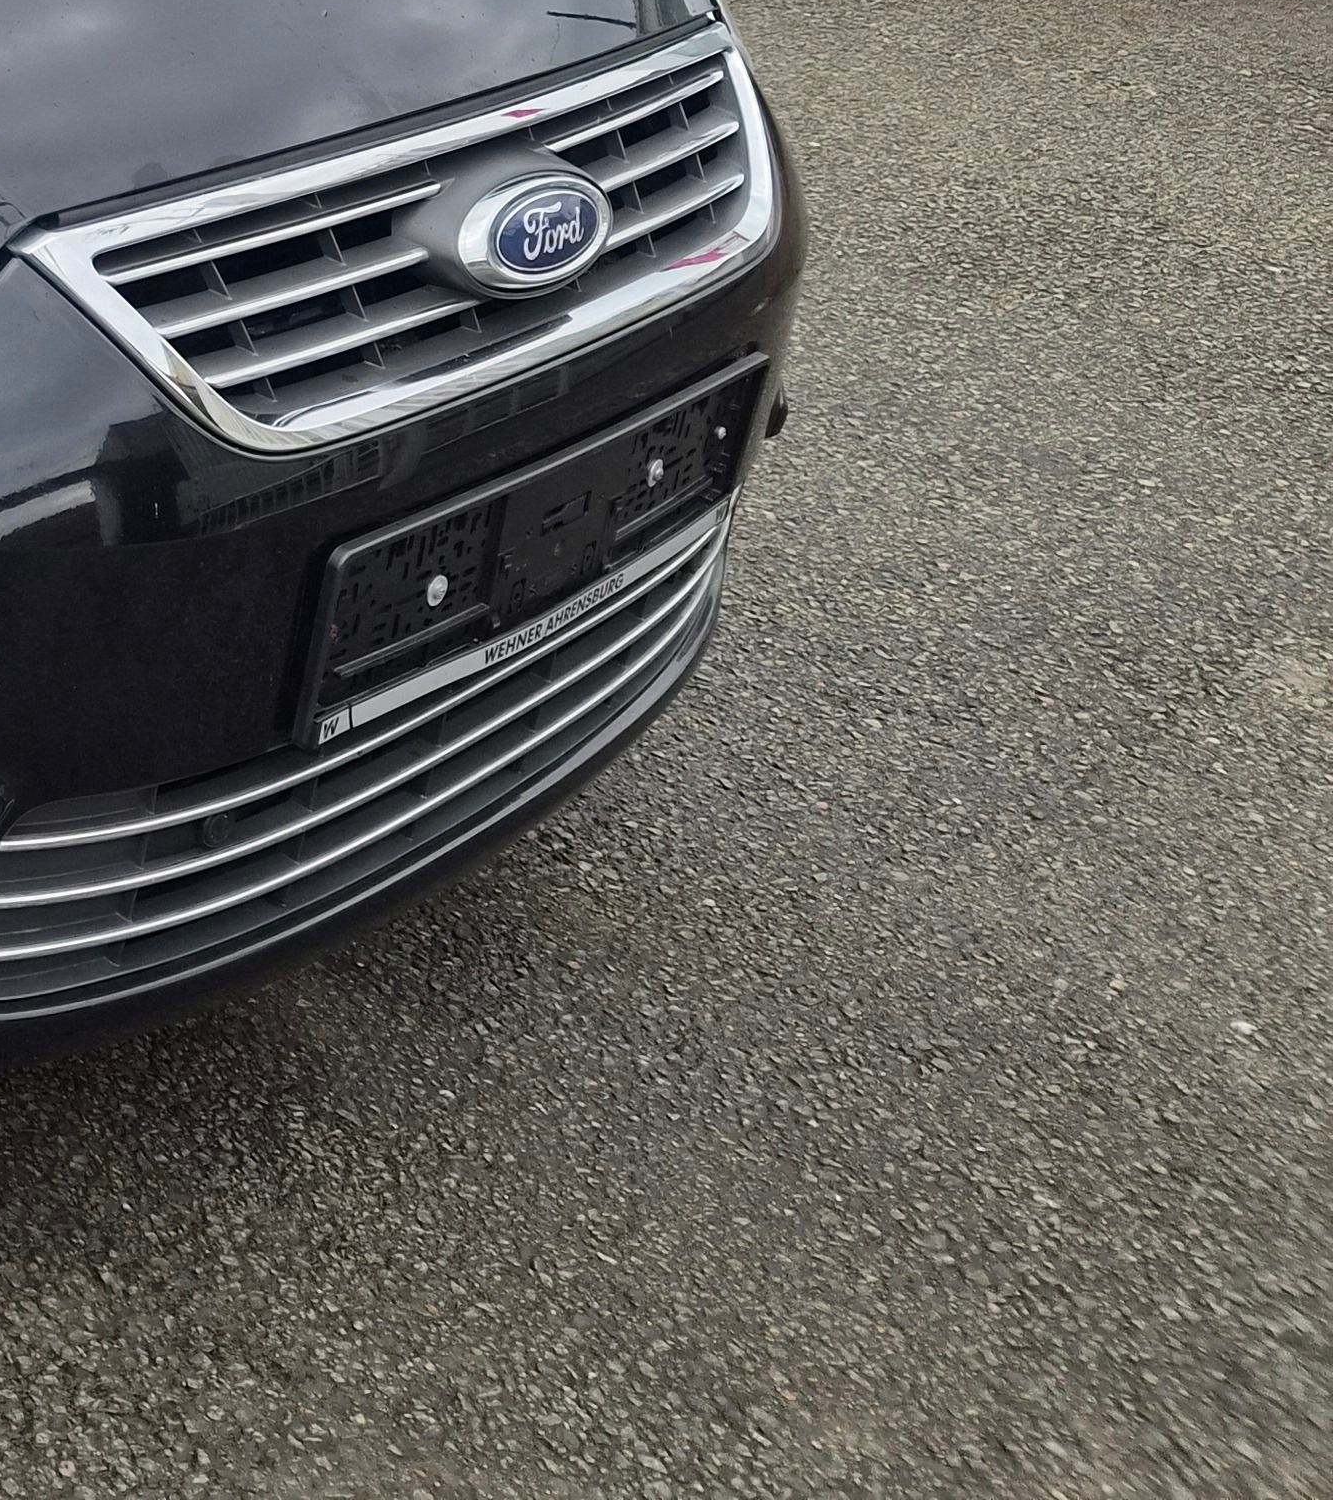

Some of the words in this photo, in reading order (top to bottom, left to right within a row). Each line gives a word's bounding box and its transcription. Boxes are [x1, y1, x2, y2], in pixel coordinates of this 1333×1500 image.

[523, 201, 585, 260] Ford
[324, 716, 340, 740] W
[484, 623, 543, 665] WEHNER
[544, 572, 625, 637] AHRENSBURG
